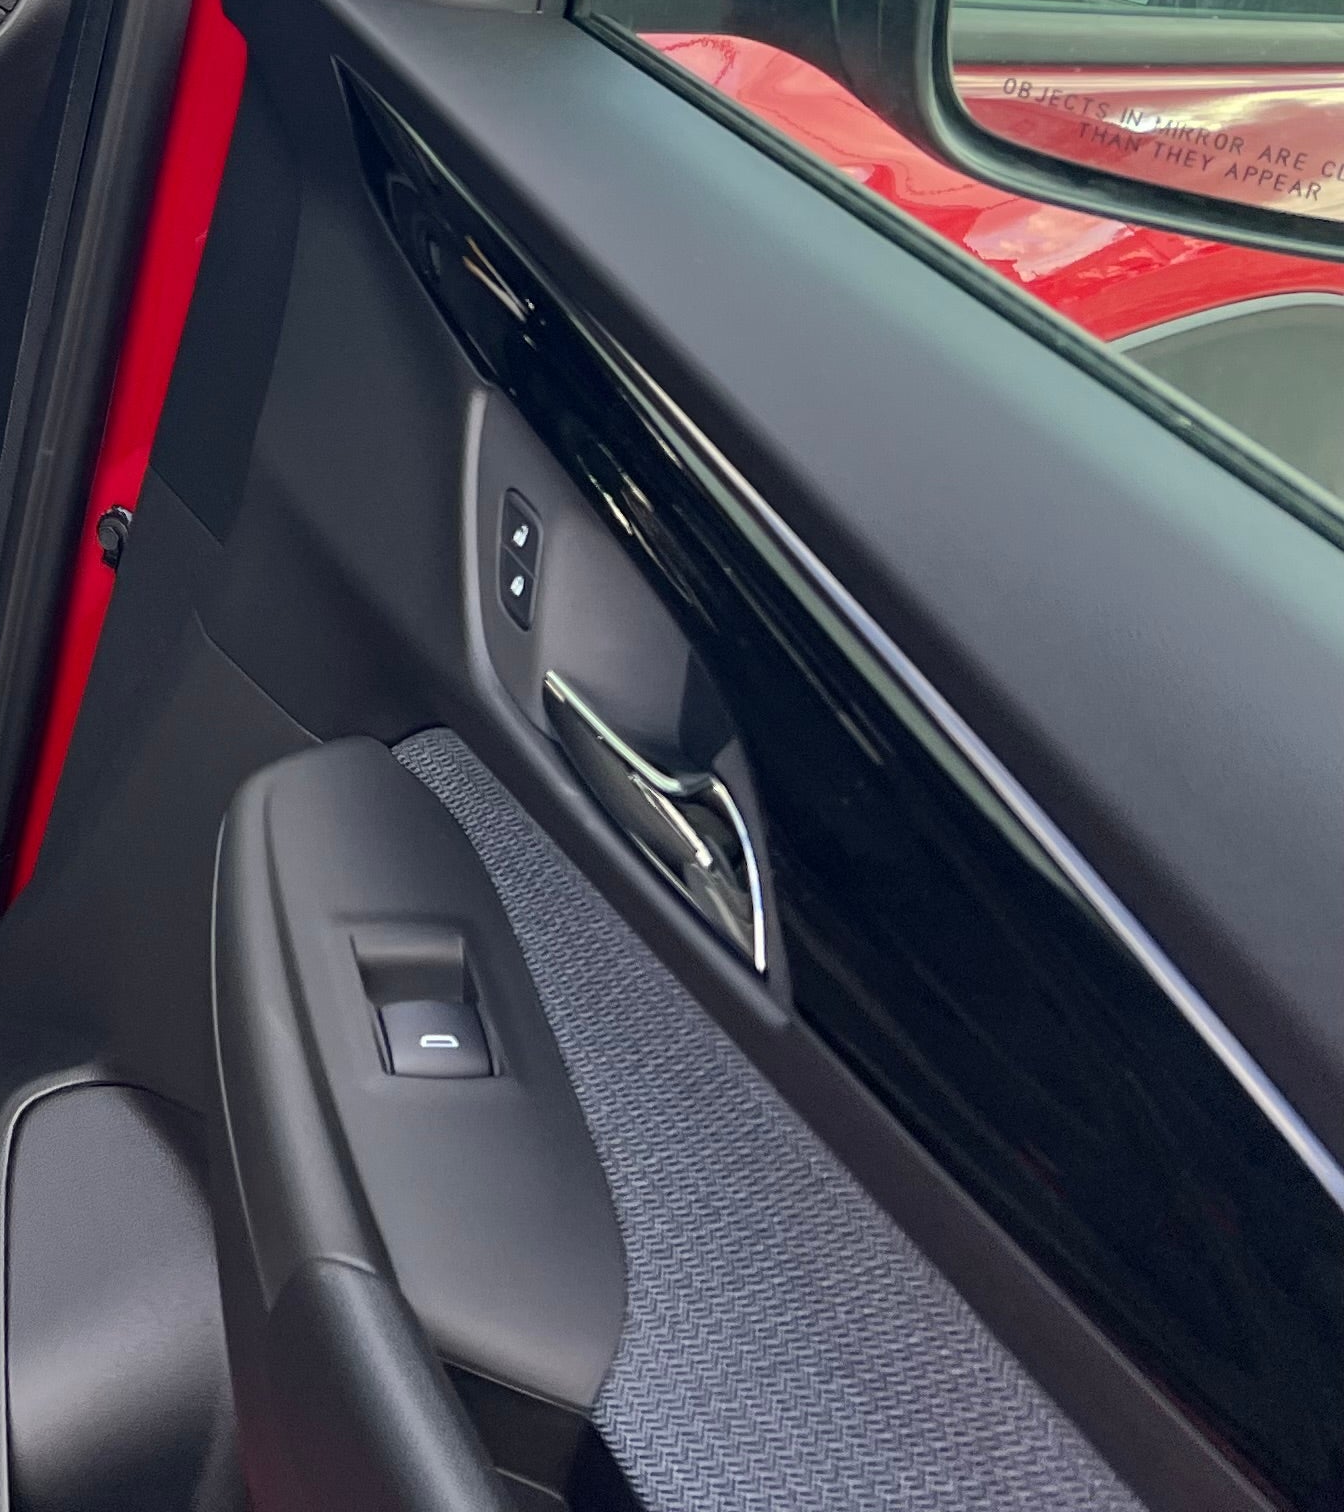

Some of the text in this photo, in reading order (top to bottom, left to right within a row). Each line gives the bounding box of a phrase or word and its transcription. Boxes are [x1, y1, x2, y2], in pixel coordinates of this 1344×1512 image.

[1002, 77, 1110, 119] OBJECTS
[1119, 107, 1144, 127] IN
[1153, 116, 1245, 156] MIRROR
[1257, 144, 1309, 172] ARE
[1078, 121, 1323, 201] THAN THEY APPEAR
